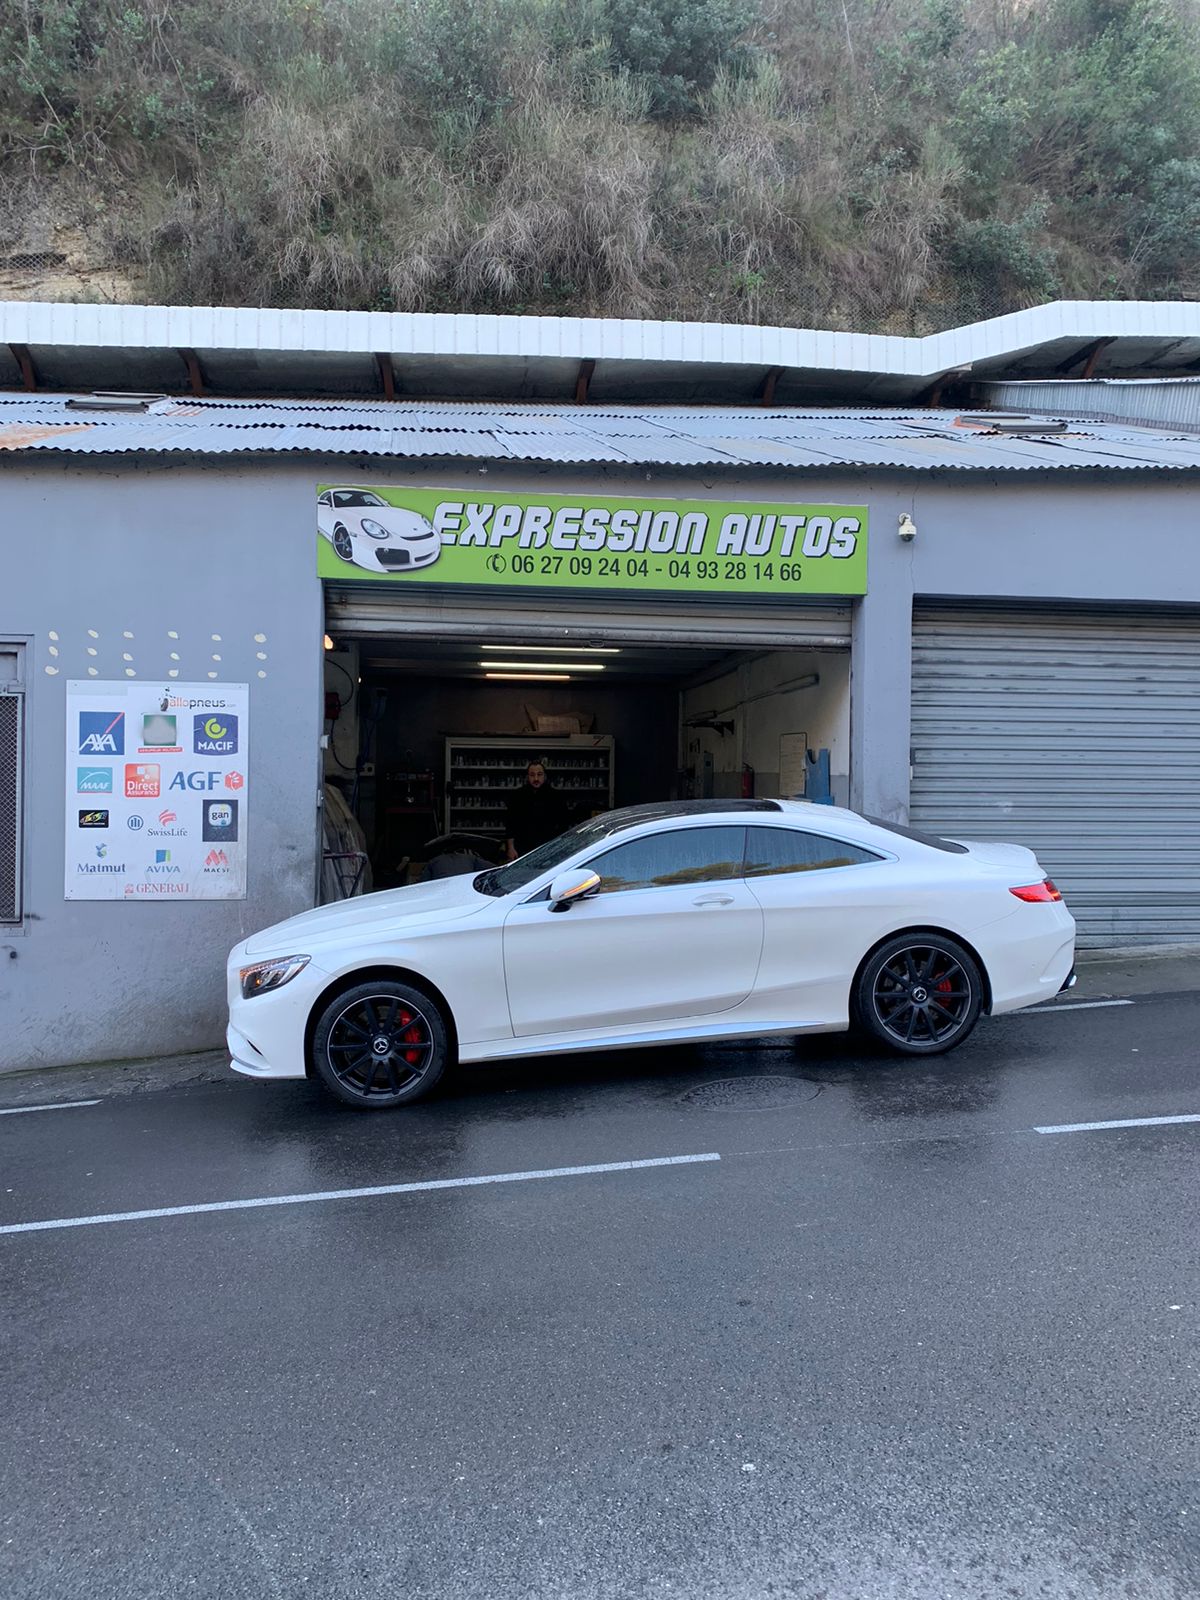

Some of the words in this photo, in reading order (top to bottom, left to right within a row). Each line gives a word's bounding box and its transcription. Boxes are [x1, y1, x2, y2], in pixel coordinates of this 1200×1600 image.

[432, 502, 709, 555] EXPRESSION
[716, 512, 861, 558] AUTOS
[511, 555, 535, 574] 06
[540, 556, 563, 575] 27
[569, 557, 592, 575] 09
[598, 558, 621, 577] 24
[626, 559, 649, 577] 04
[668, 560, 691, 579] 04
[696, 561, 719, 580] 93
[724, 562, 747, 580] 28
[753, 563, 775, 581] 14
[779, 563, 802, 582] 66
[79, 733, 118, 752] AXA
[197, 741, 234, 751] MACIF
[127, 780, 159, 791] Direct
[169, 771, 222, 791] AGF
[211, 811, 230, 821] gan
[77, 863, 126, 873] Matmut
[146, 865, 181, 873] AVIVA
